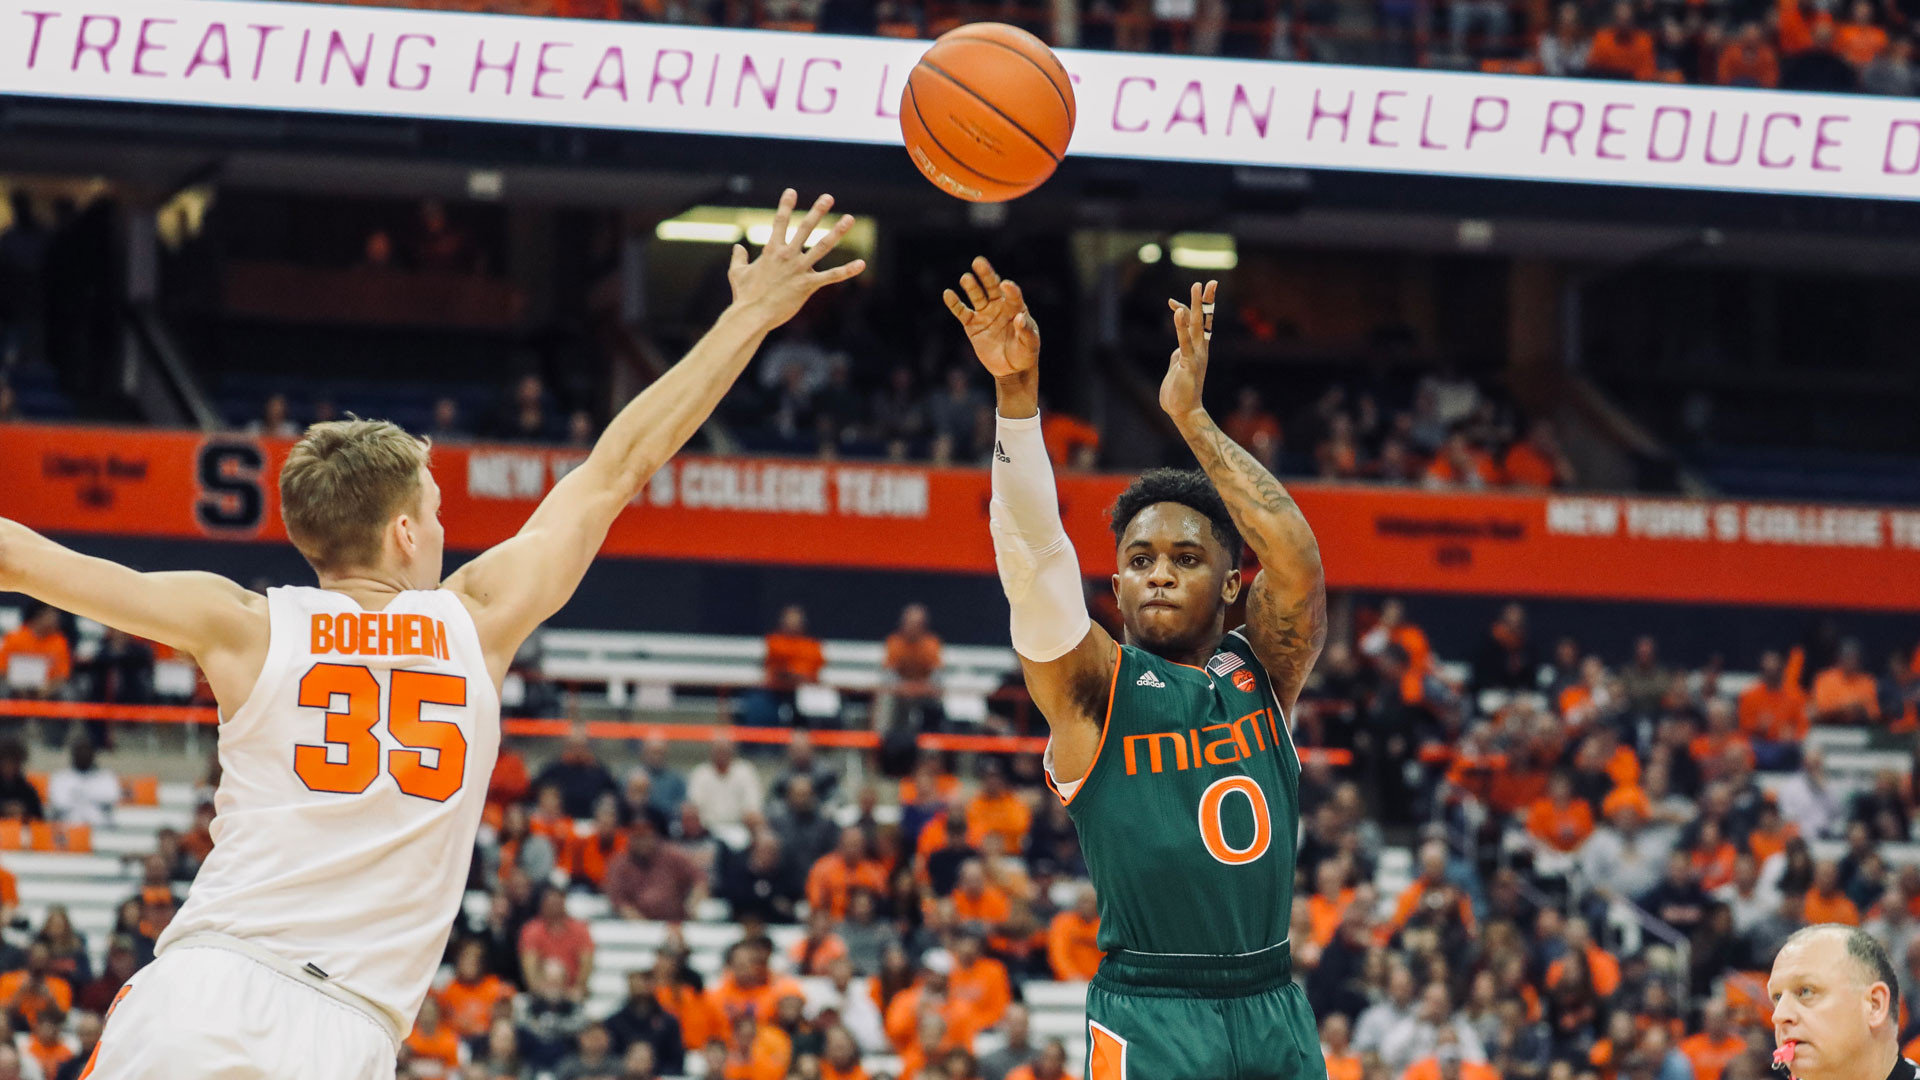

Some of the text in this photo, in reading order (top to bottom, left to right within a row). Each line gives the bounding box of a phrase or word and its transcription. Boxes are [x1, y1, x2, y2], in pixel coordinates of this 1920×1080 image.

[21, 10, 437, 92] TREATING
[469, 39, 842, 115] HEARING
[1111, 75, 1276, 140] CAN
[1307, 88, 1511, 150] HELP
[1540, 99, 1850, 172] REDUCE
[198, 441, 264, 530] S
[468, 455, 543, 501] NEW
[681, 460, 826, 515] COLLEGE
[837, 468, 928, 520] TEAM
[1547, 499, 1618, 536] NEW
[1744, 505, 1882, 548] COLLEGE
[1136, 680, 1166, 688] adidas
[294, 661, 467, 803] 35
[1198, 775, 1272, 866] 0
